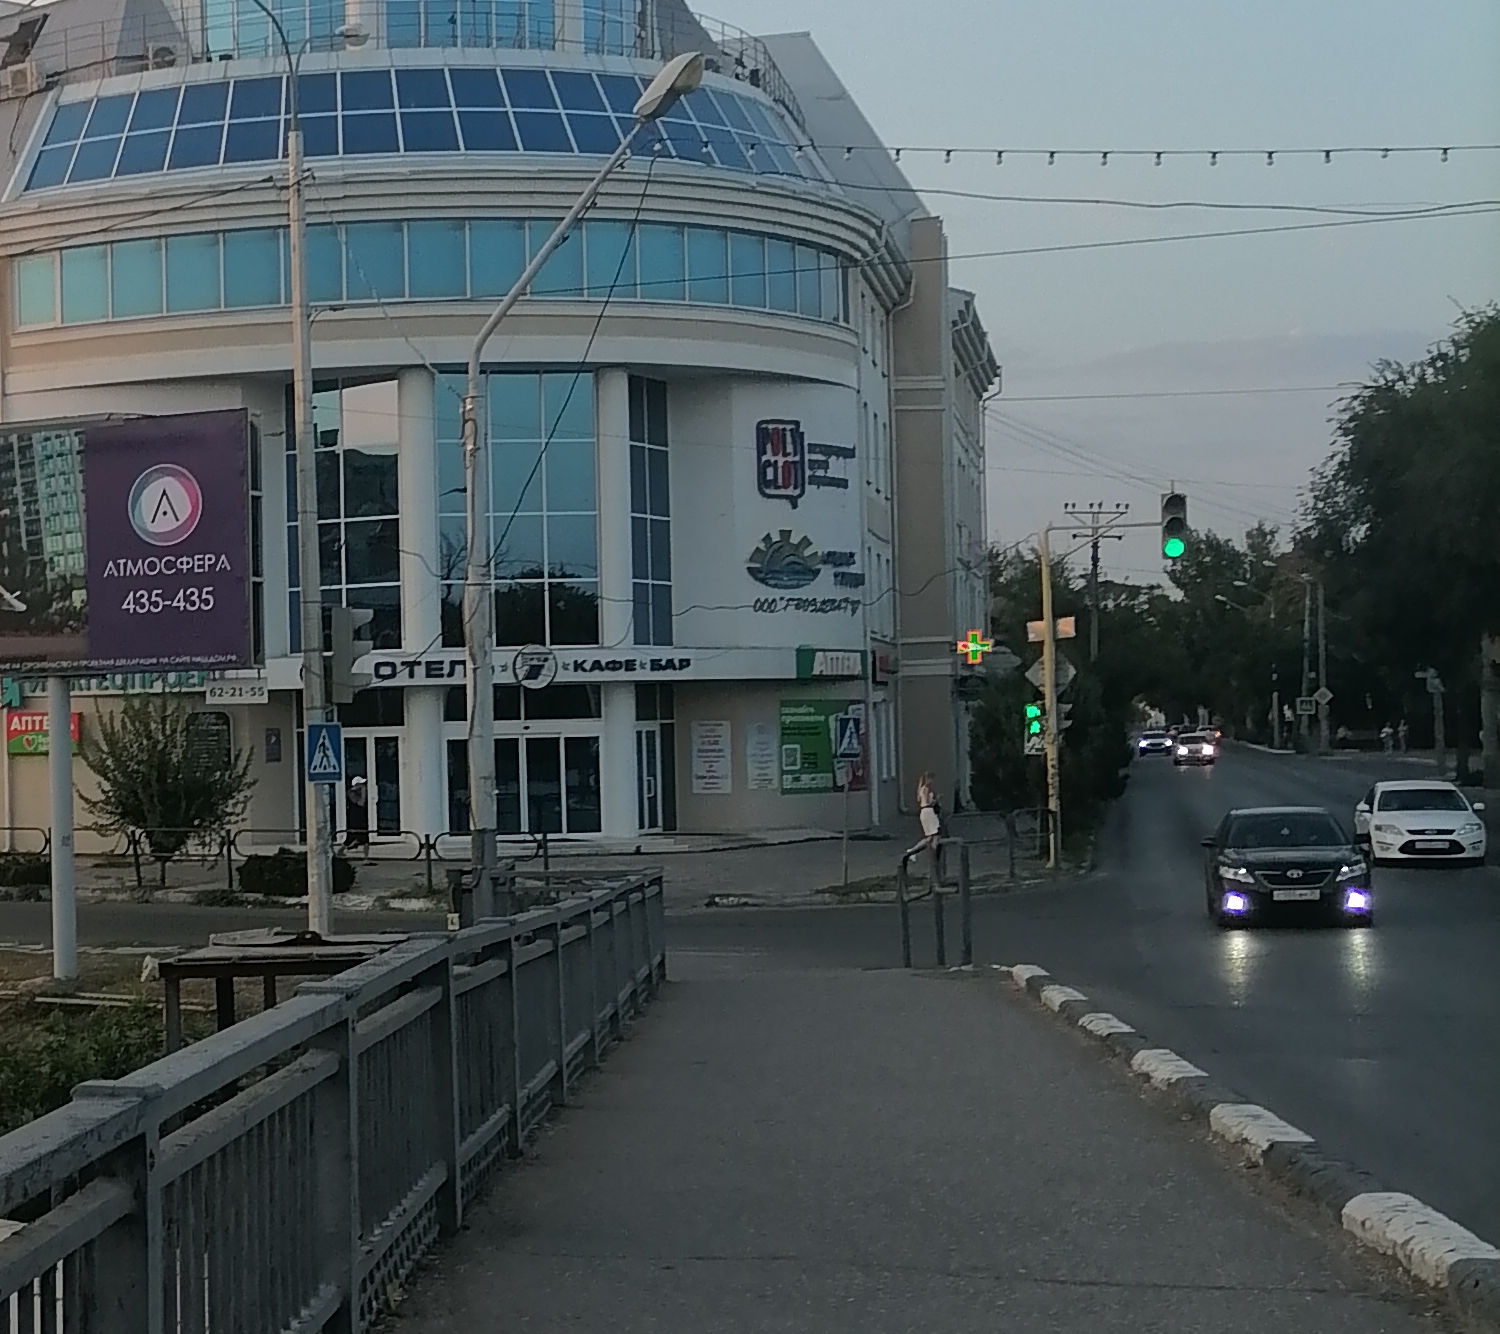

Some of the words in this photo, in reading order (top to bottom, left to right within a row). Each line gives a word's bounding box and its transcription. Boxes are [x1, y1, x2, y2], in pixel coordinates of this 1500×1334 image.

[103, 553, 232, 578] АТМОСФЕРА
[121, 586, 216, 614] 435-435
[374, 660, 495, 679] ОТЕЛ
[573, 658, 637, 672] КАФЕ
[650, 657, 692, 672] БАР
[209, 686, 265, 698] 62-21-55
